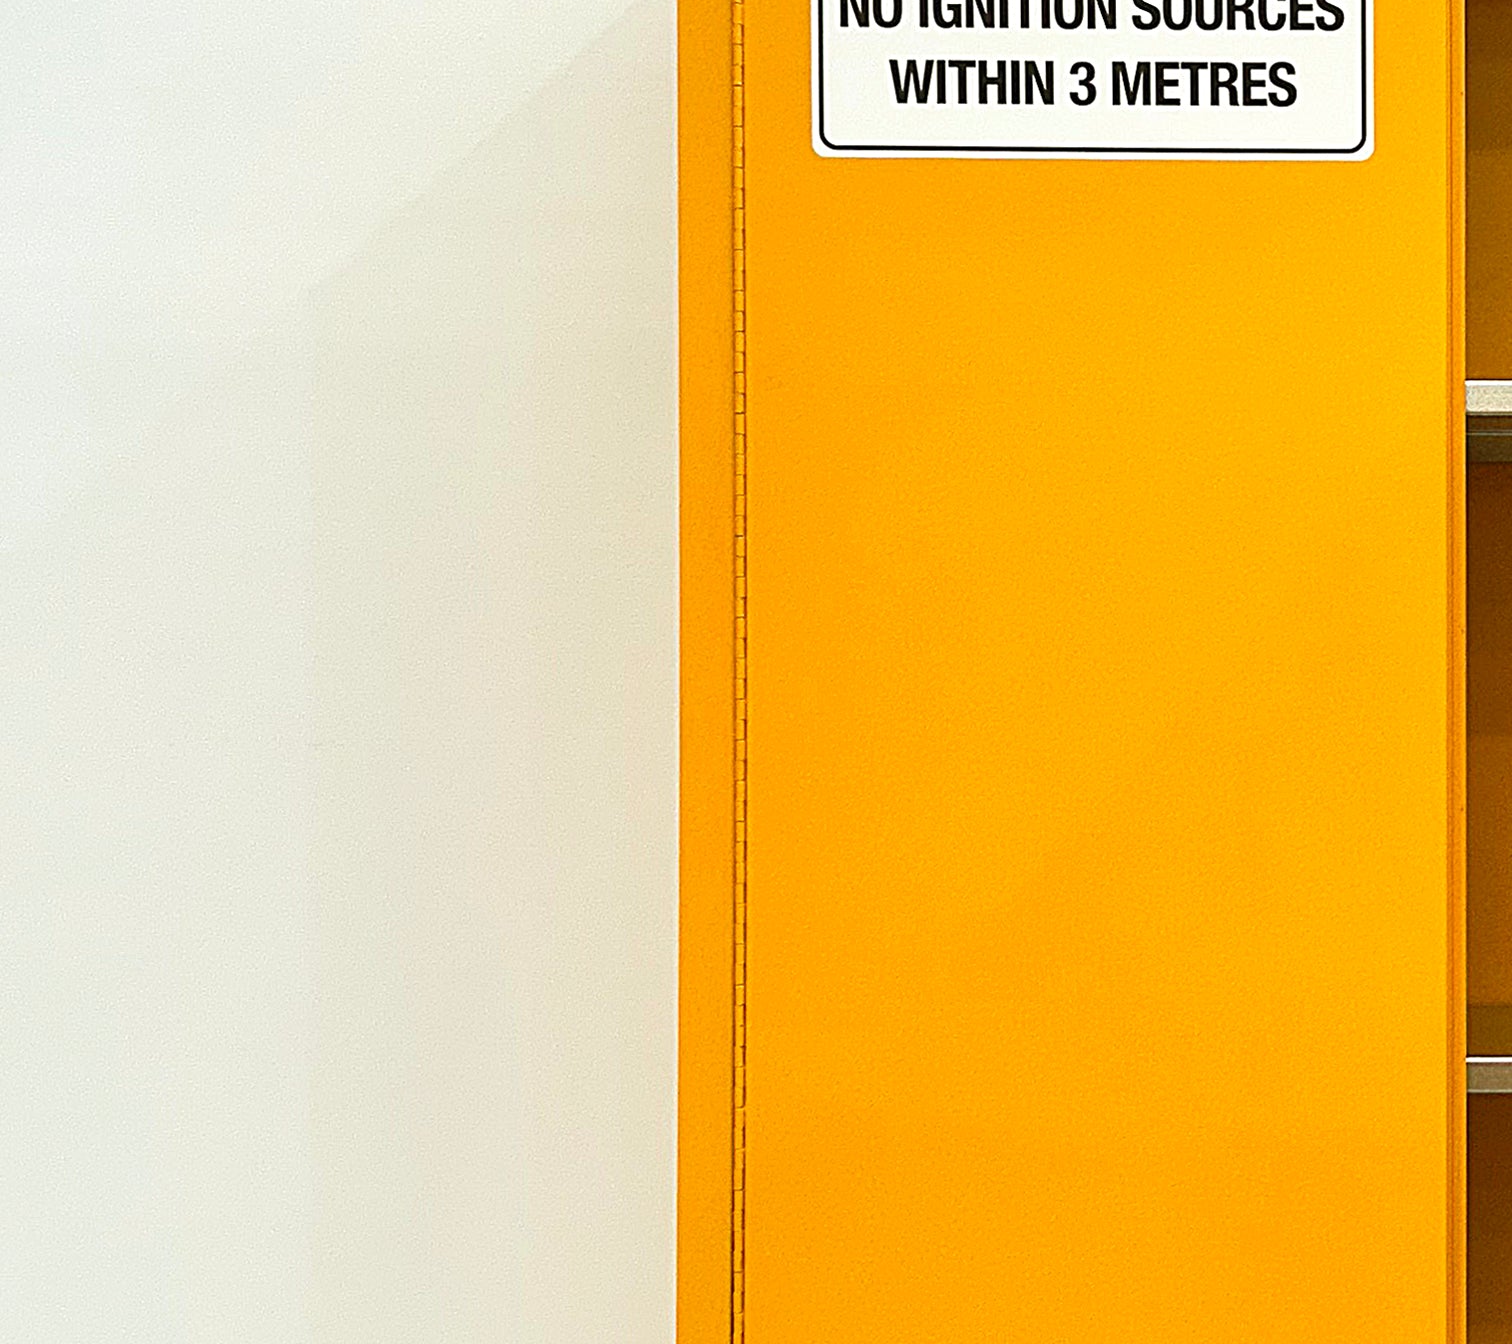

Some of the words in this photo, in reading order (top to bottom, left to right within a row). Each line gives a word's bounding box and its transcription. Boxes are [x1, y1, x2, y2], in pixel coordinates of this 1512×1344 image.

[889, 60, 1054, 105] WITHIN
[1070, 62, 1096, 106] 3
[1112, 61, 1297, 107] METRES
